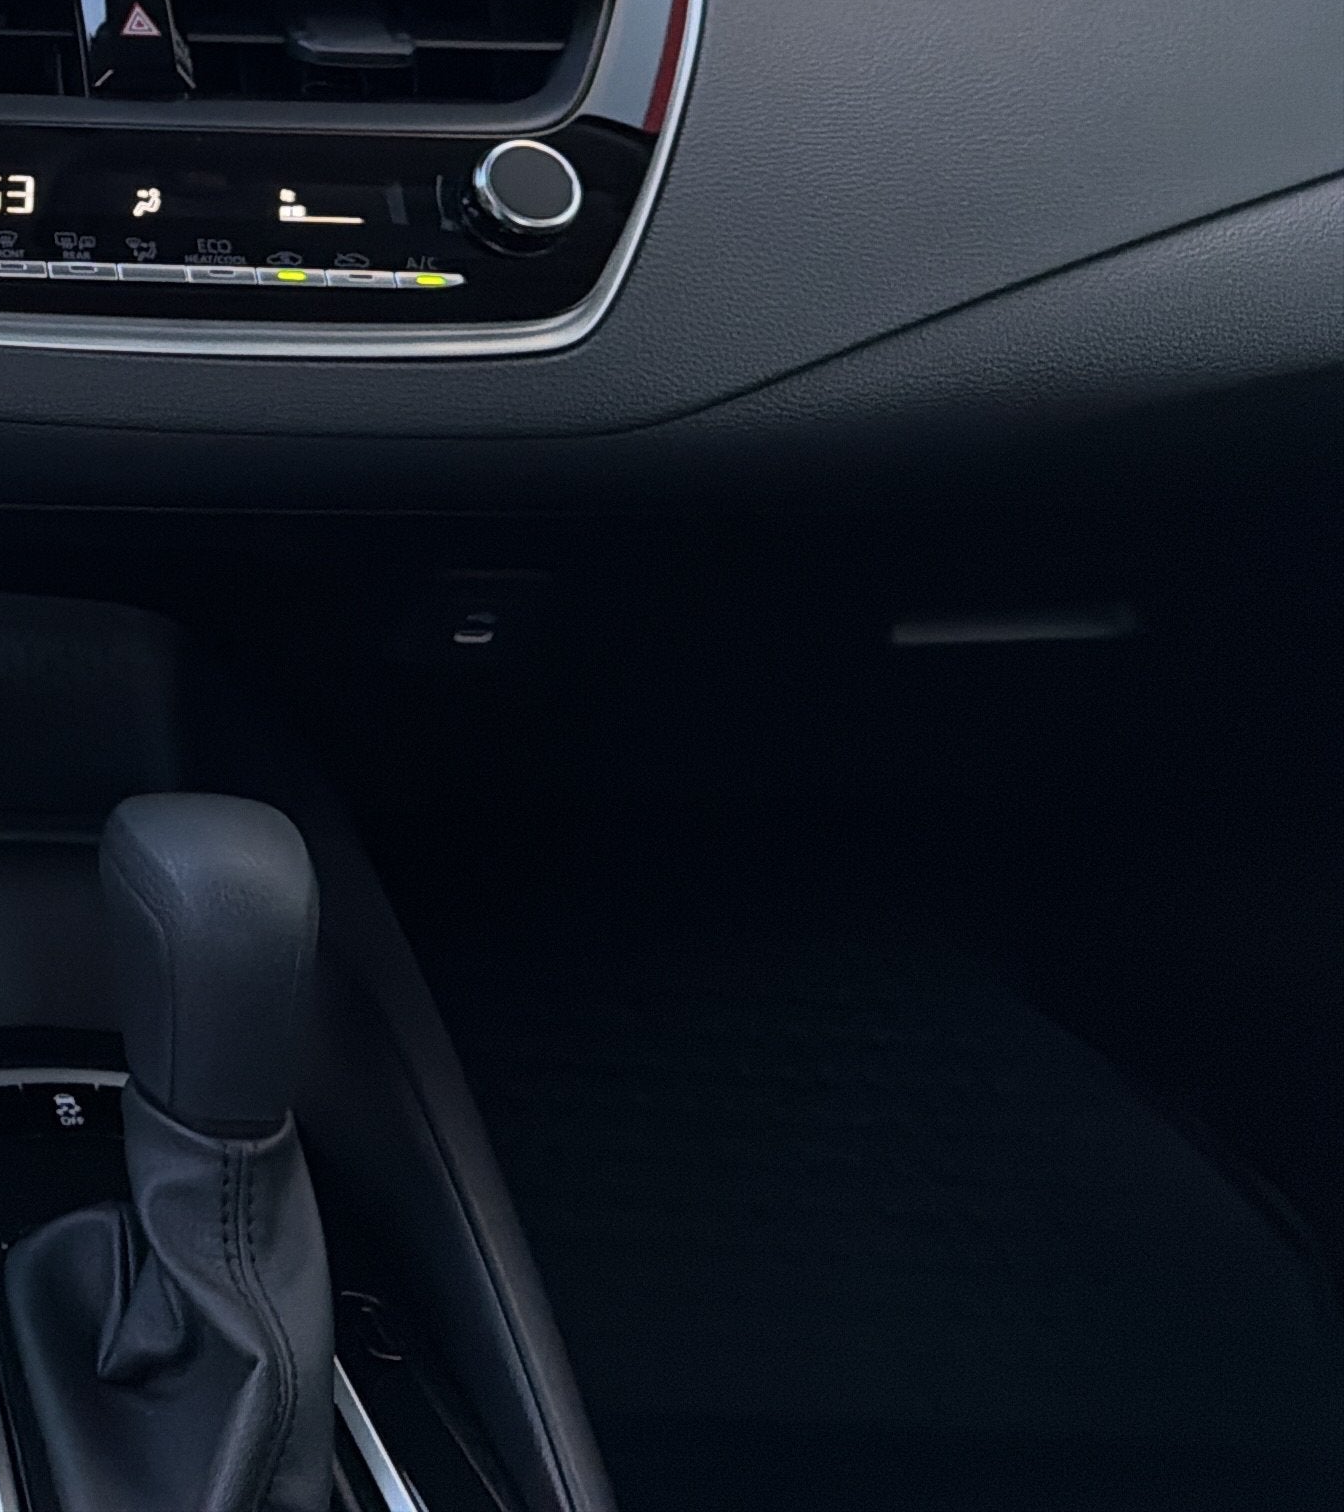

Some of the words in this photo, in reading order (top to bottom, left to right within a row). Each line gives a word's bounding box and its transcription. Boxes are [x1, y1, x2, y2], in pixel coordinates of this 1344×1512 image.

[196, 238, 232, 254] ECO
[63, 251, 91, 260] REAR
[184, 254, 247, 265] HEAT/COOL
[406, 256, 438, 269] A/C
